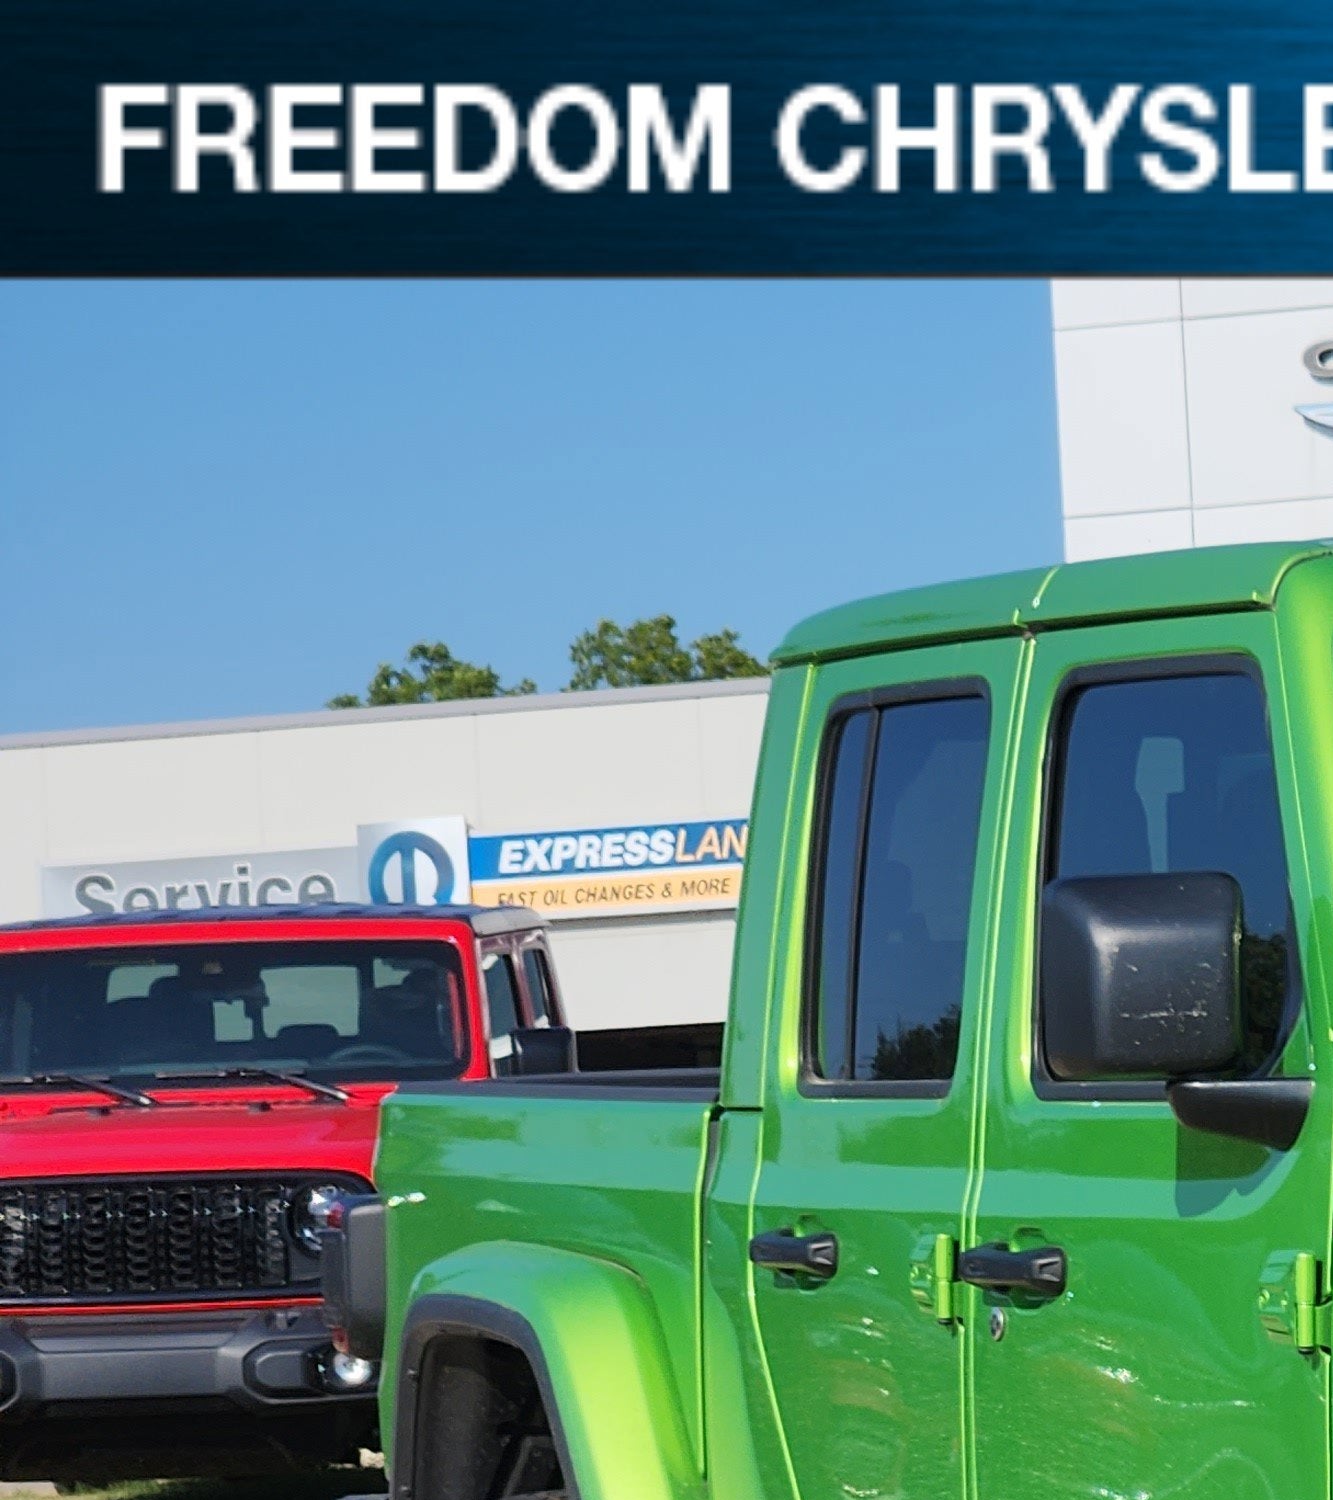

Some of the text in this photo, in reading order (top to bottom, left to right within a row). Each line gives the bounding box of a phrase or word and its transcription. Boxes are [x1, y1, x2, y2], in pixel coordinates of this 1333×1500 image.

[73, 862, 337, 914] Service
[497, 877, 731, 906] FAST OIL CHANGES & MORE
